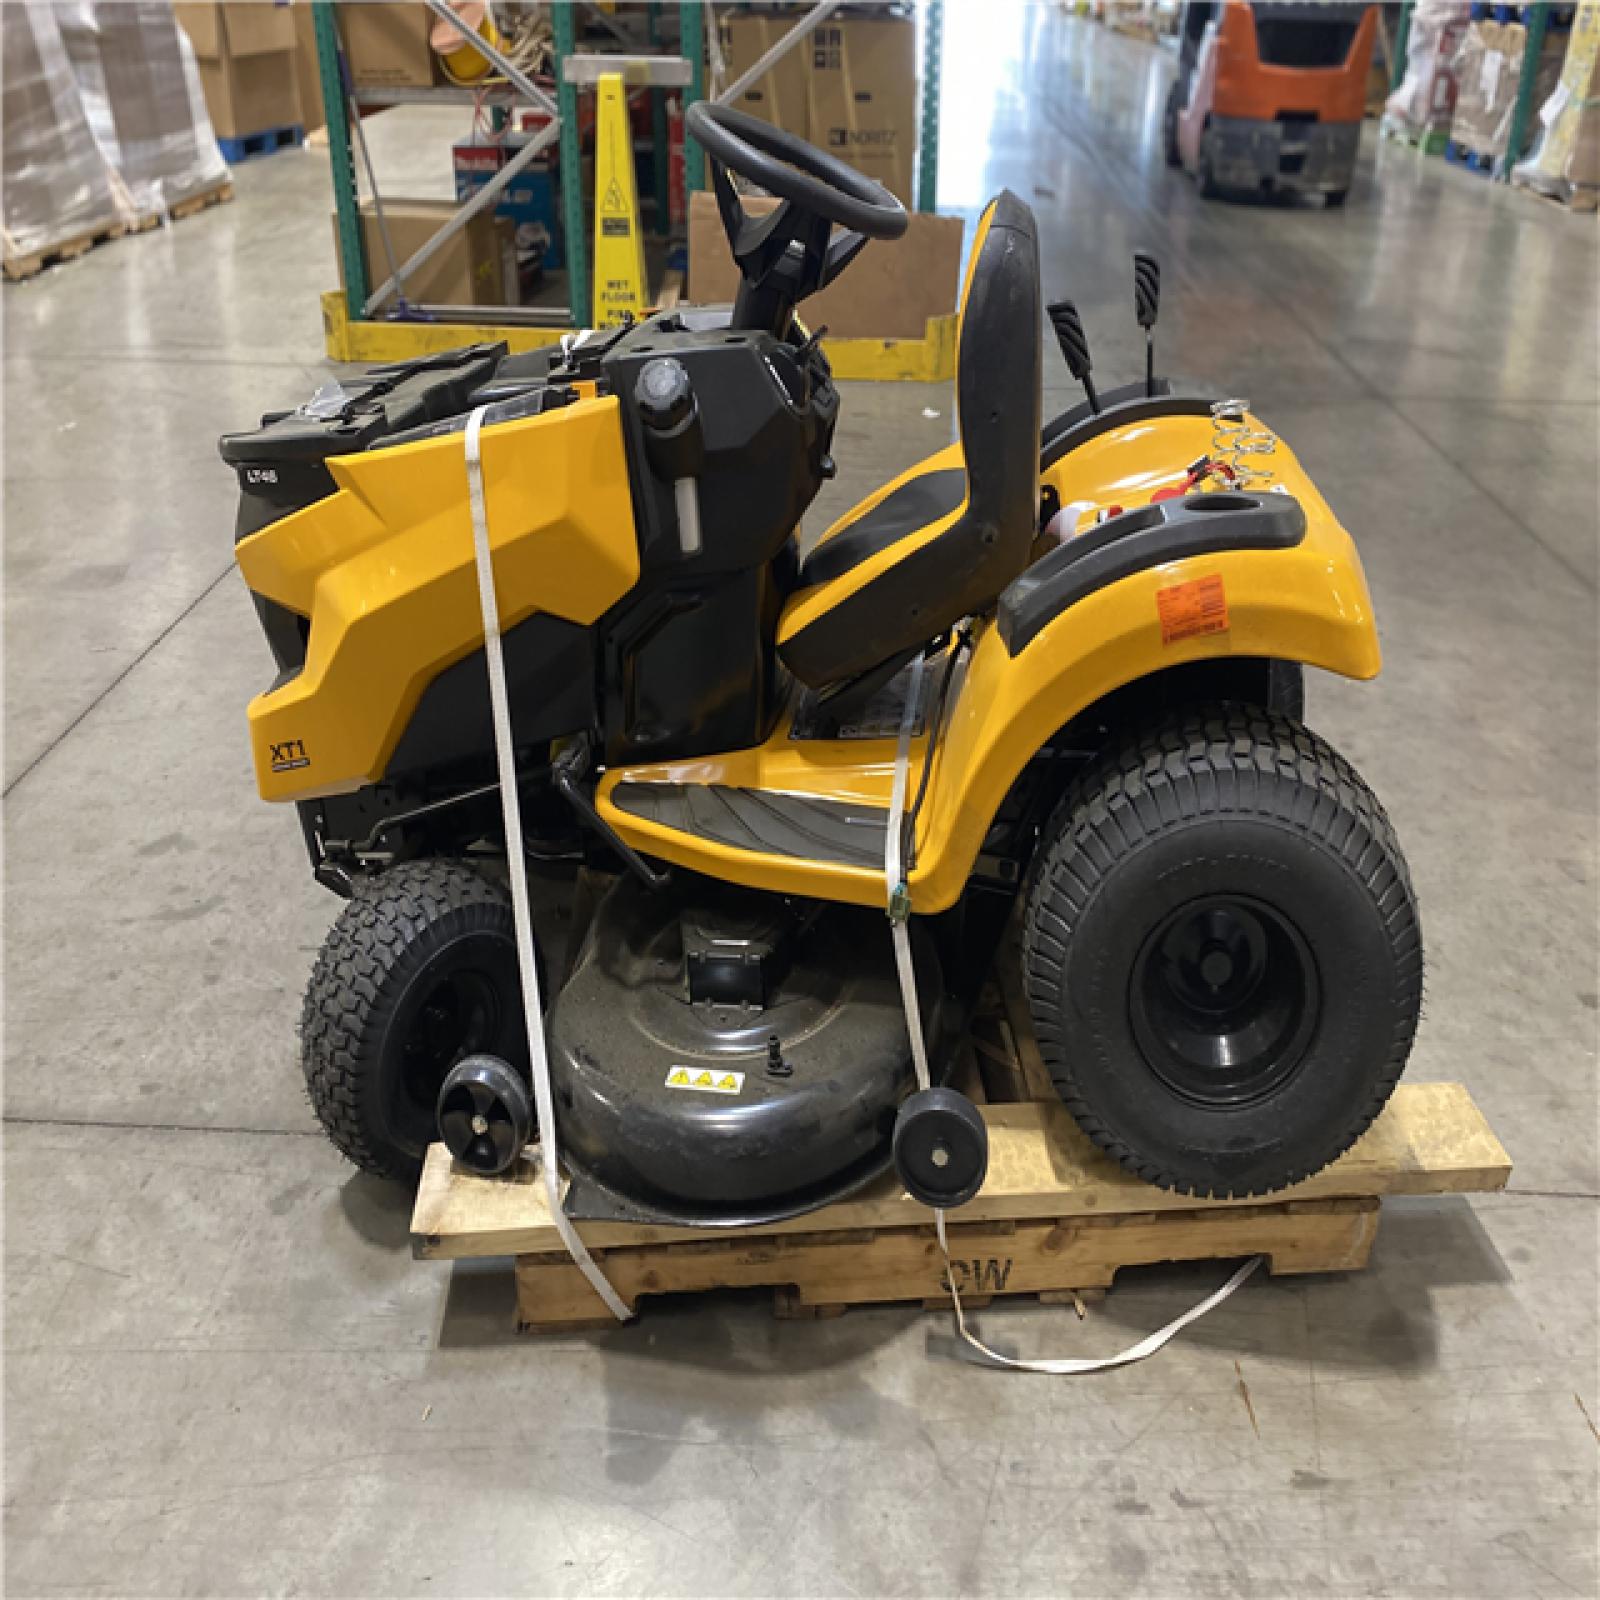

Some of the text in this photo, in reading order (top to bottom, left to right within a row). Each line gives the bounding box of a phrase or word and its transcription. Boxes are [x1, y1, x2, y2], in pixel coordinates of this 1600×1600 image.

[607, 280, 628, 289] WET
[601, 291, 636, 302] FLOOR
[269, 739, 305, 761] XT1
